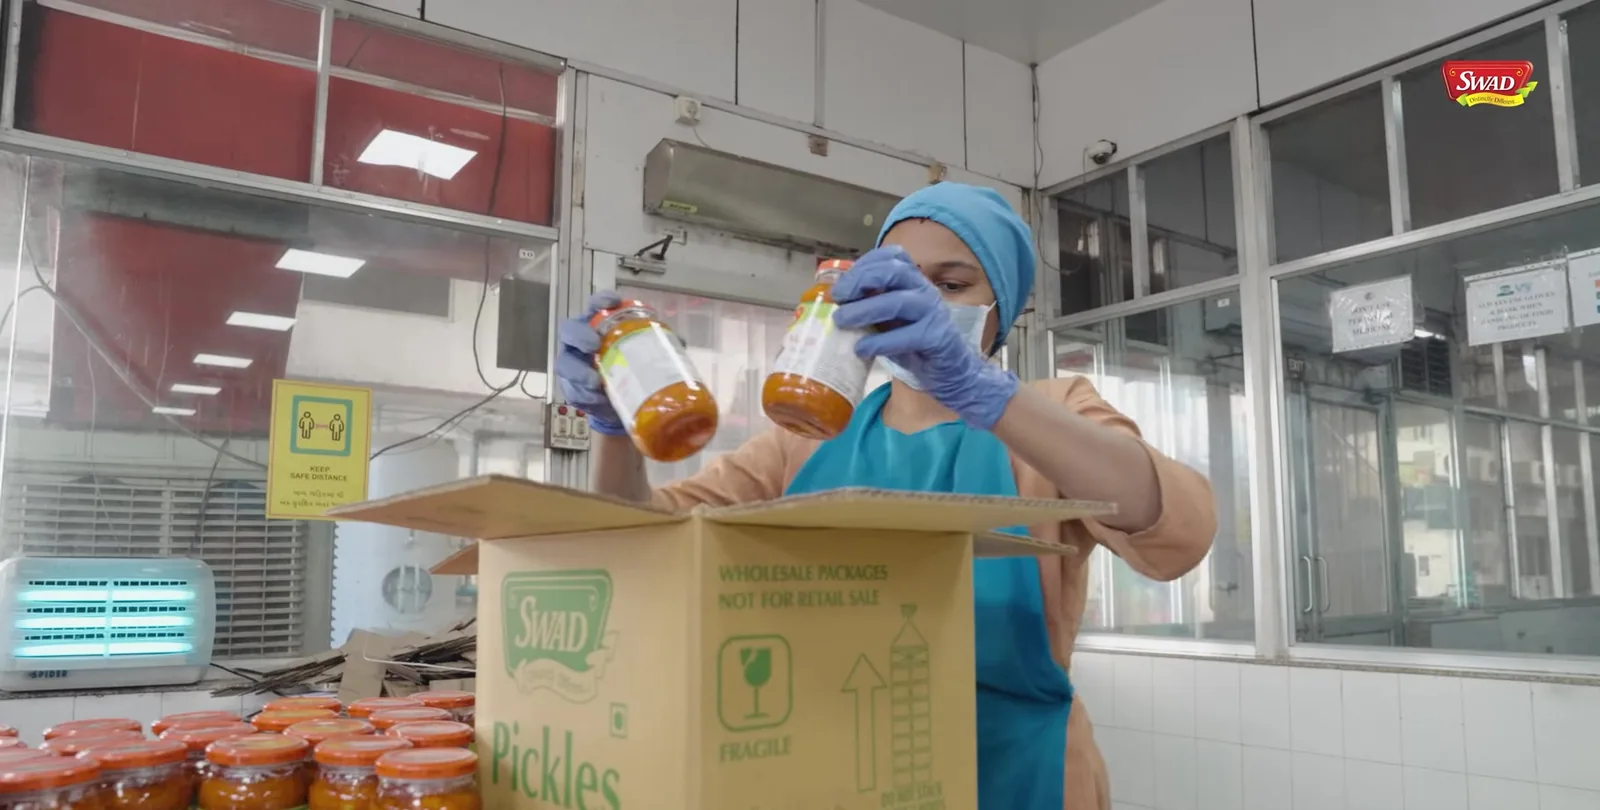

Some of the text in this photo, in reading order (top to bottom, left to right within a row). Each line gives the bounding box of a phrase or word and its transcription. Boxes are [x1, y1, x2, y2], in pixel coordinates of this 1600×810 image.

[290, 472, 348, 482] SAFE DISTANCE
[310, 465, 330, 473] KEEP
[719, 564, 888, 582] WHOLESALE PACKAGES
[719, 588, 880, 610] NOT FOR RETAIL SALE
[515, 595, 588, 653] SWAD
[31, 669, 68, 678] SPIDER
[719, 735, 792, 763] FRAGILE
[491, 720, 621, 810] Pickles
